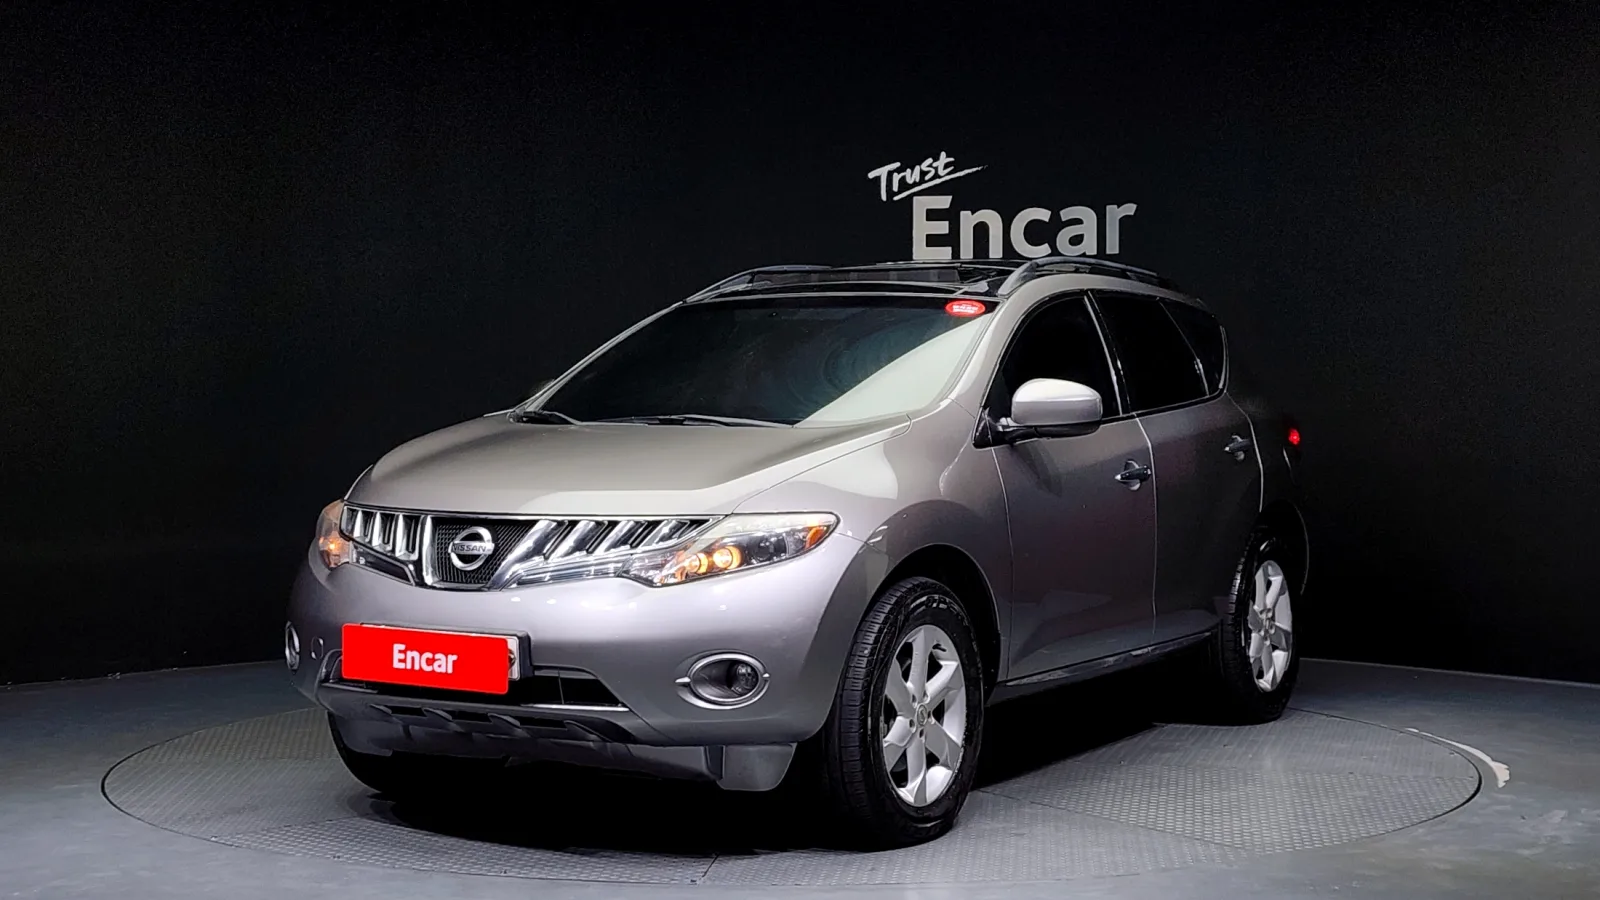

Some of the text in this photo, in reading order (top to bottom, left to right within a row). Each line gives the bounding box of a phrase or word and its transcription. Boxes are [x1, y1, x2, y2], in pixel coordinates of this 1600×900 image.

[868, 151, 955, 202] Trust
[912, 195, 1138, 261] Encar
[452, 544, 487, 552] NISSAN
